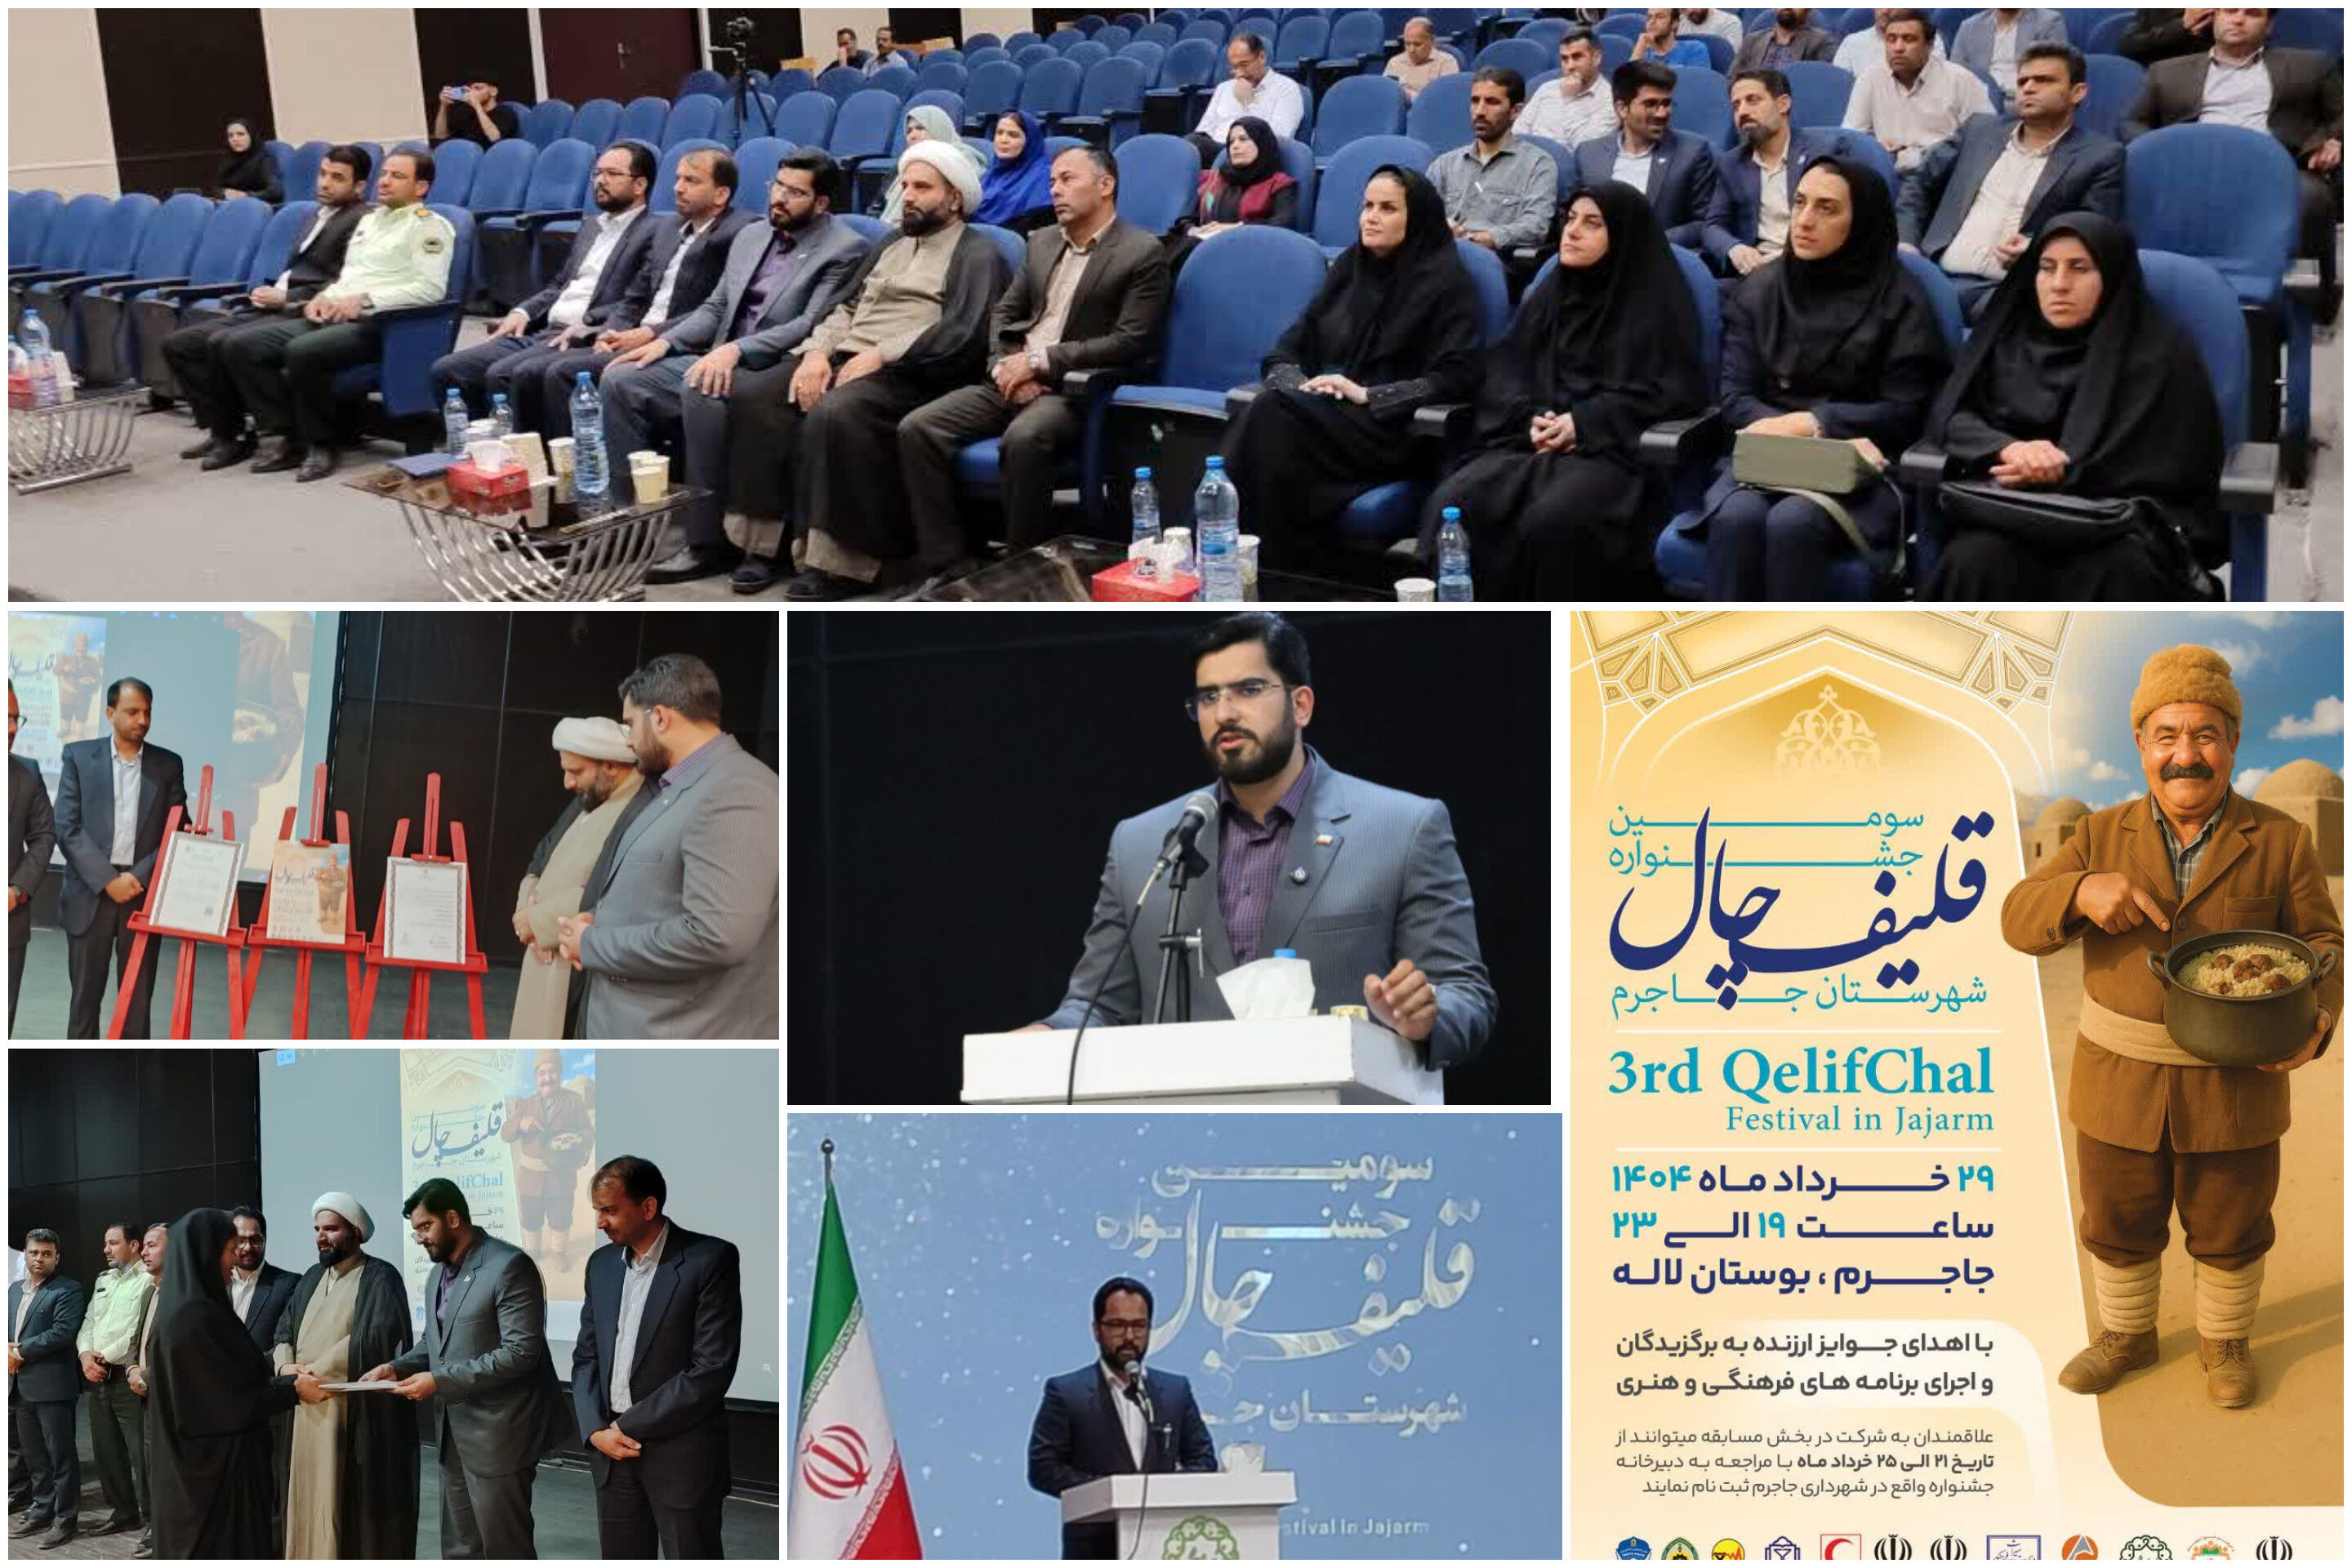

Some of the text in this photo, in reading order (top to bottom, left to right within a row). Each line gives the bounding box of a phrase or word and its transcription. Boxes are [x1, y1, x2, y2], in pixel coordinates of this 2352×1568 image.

[1609, 805, 1924, 837] سومین
[1609, 840, 1923, 876] جشنواره
[1611, 973, 1987, 1021] شهرستان جاجرم
[1608, 1046, 1995, 1104] 3rd QelifChal
[1726, 1105, 1994, 1139] Festival in Jajarm
[1152, 1153, 1433, 1197] سومین
[1612, 1164, 1994, 1201] ۲۹ خرداد ماه ۱۴۰۴
[1612, 1211, 1994, 1249] ساعت ۱۹ الی ۲۳
[1613, 1258, 1682, 1285] لاله
[1690, 1258, 1811, 1295] بوستان
[1834, 1258, 1995, 1295] جاجرم
[1616, 1328, 1993, 1358] با اهدای جوایز ارزنده به برگزیدگان
[1616, 1366, 1993, 1396] و اجرای برنامه های فرهنگی و هنری
[1615, 1428, 1993, 1448] علاقمندان به شرکت در بخش مسابقه میتوانند از
[1616, 1454, 1994, 1474] تاریخ ۲۱ الی ۲۵ خرداد ماه با مراجعه به دبیرخانه
[1642, 1478, 1993, 1499] جشنواره واقع در شهرداری جاجرم ثبت نام نمایند
